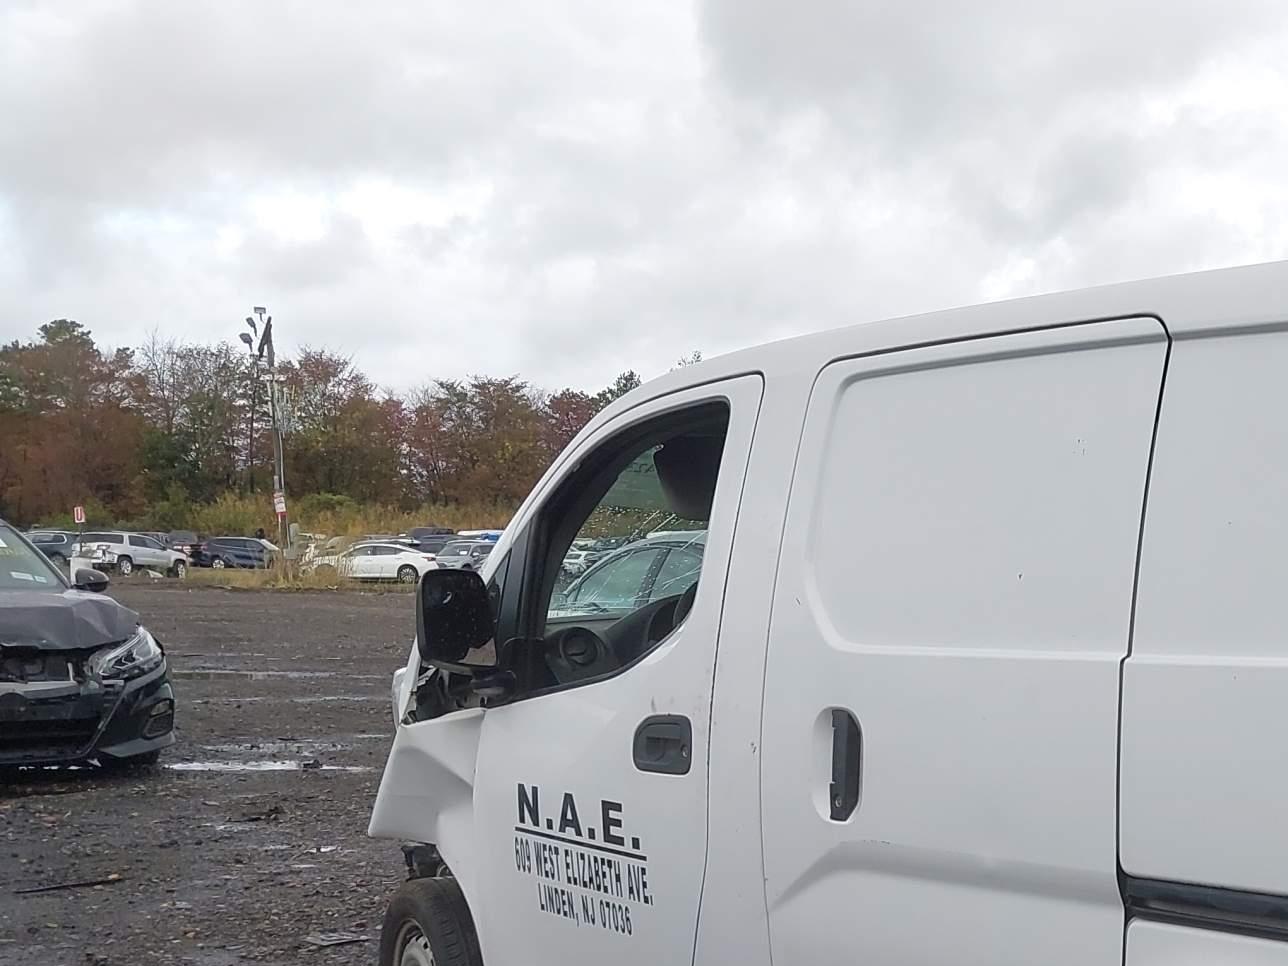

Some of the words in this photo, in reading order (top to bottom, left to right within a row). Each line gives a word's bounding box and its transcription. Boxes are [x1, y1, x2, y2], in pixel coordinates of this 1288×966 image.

[517, 783, 640, 850] N.A.E.
[515, 837, 531, 874] 609
[534, 841, 560, 882] WEST
[565, 849, 623, 898] ELIZABETH
[538, 883, 580, 927] LINDEN,
[581, 894, 596, 926] NJ
[599, 899, 632, 936] 07036
